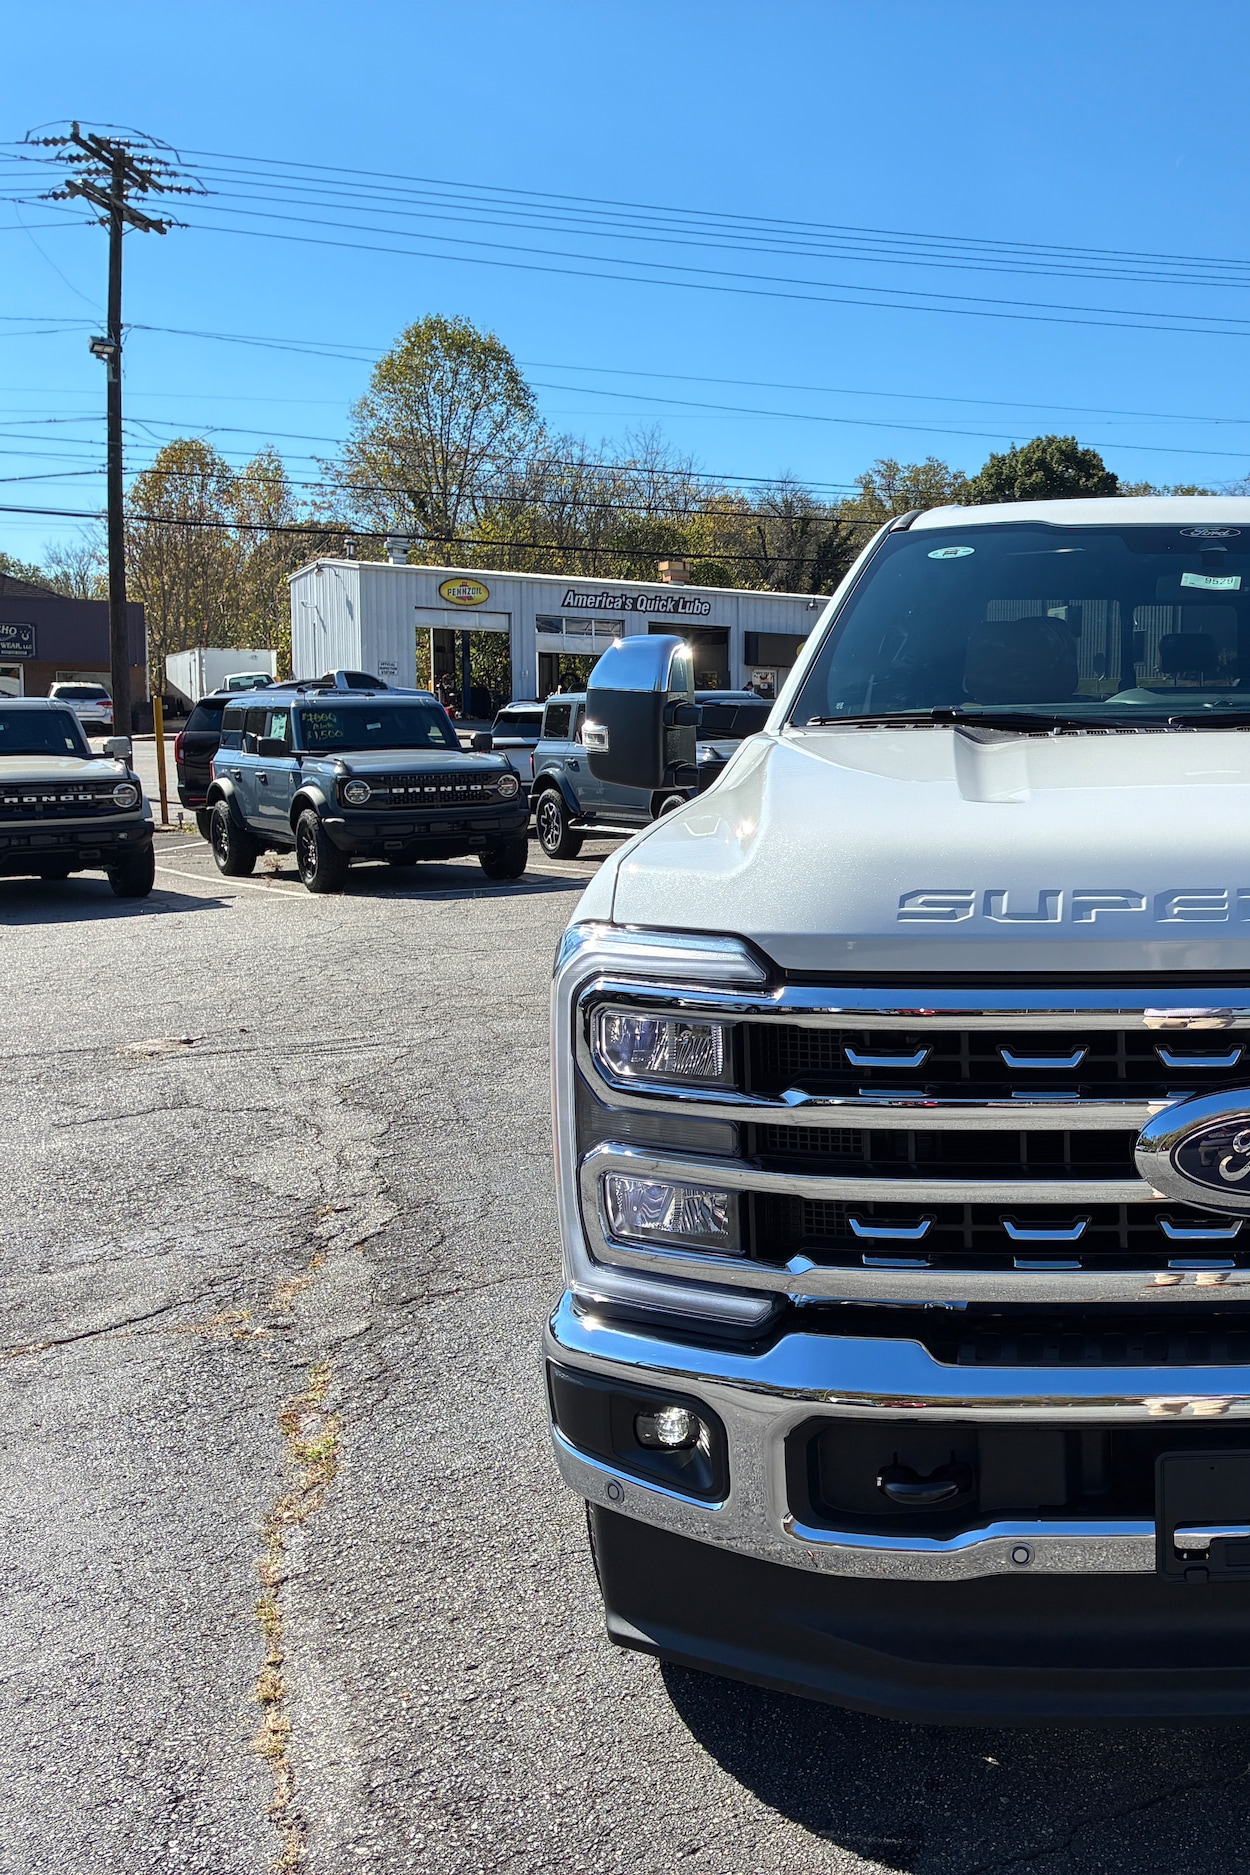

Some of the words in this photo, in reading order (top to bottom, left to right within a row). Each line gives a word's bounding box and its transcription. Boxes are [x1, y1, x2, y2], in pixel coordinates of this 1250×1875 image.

[1190, 528, 1231, 537] Ford
[447, 586, 483, 597] PENNZOIL
[563, 590, 633, 610] America's
[636, 594, 676, 613] Quick
[677, 597, 711, 615] Lube
[0, 625, 18, 636] HO
[391, 784, 482, 794] BRONCO
